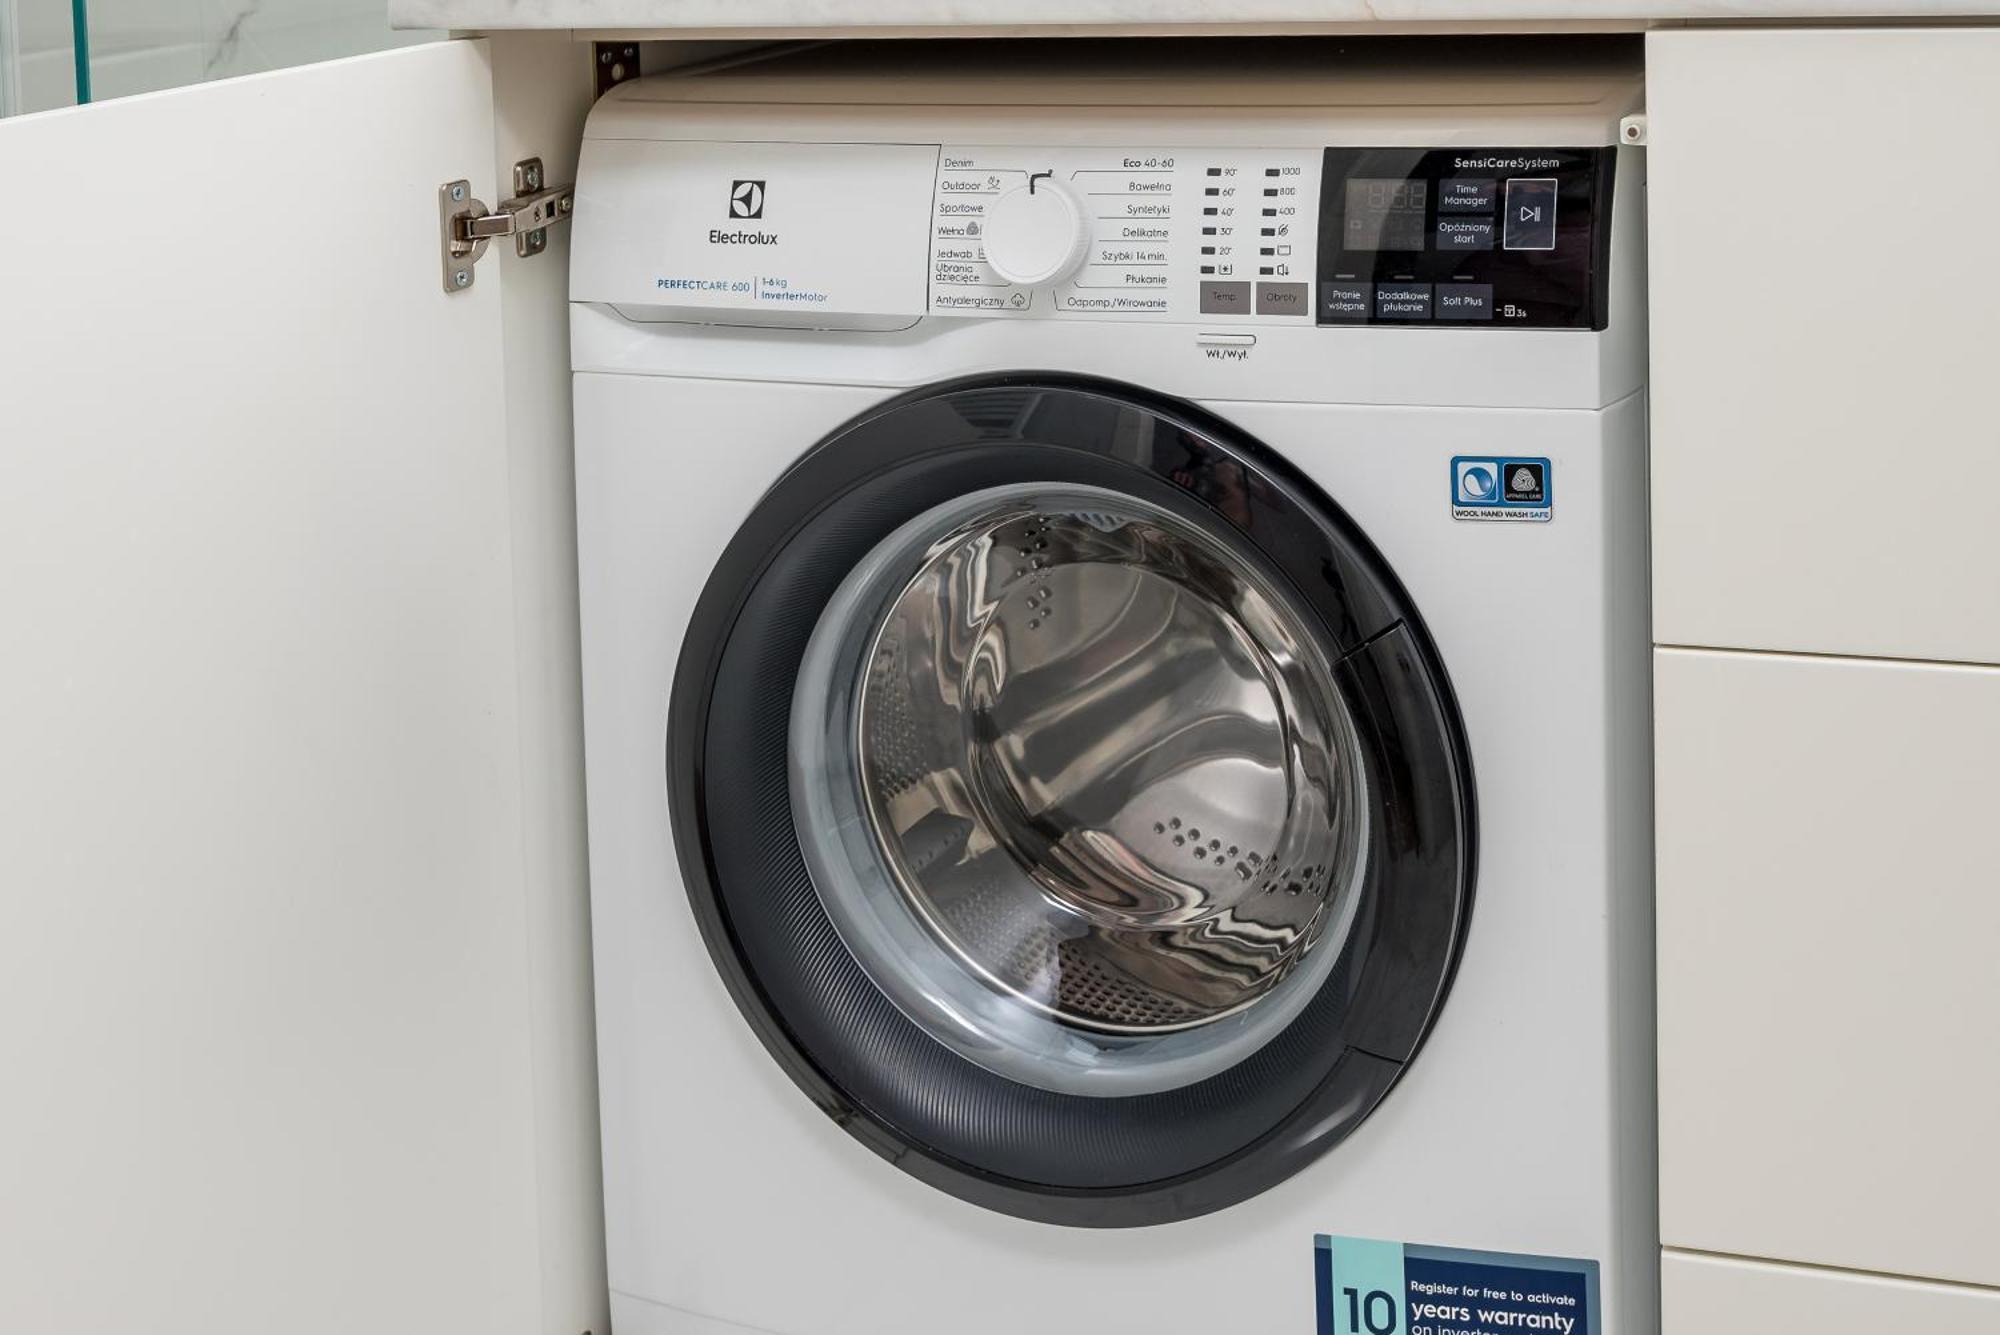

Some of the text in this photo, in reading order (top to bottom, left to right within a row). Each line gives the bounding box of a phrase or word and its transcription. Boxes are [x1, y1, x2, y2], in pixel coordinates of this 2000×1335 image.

[944, 158, 974, 168] Denim
[1123, 158, 1174, 168] Eco 40-60
[1454, 158, 1560, 170] SensiCareSystem
[1281, 167, 1301, 176] 1000
[941, 181, 981, 190] Outdoor
[1455, 184, 1478, 194] Time
[1280, 187, 1296, 196] 800
[1444, 196, 1488, 207] Manager
[939, 203, 984, 214] Sportowe
[1127, 204, 1170, 216] Syntetyki
[1279, 207, 1296, 216] 400
[709, 230, 778, 246] Electrolux
[1122, 227, 1169, 238] Delikatne
[1453, 234, 1475, 245] start
[937, 249, 973, 259] Jedwab
[1102, 250, 1168, 262] Szybki 14 min.
[935, 263, 973, 273] Ubrania
[762, 277, 788, 289] 1-6 kg
[1126, 274, 1168, 284] Płukanie
[657, 279, 750, 292] PERFECTCARE 600
[761, 290, 828, 302] InverterMotor
[1266, 292, 1297, 303] Obroty
[1332, 290, 1361, 300] Pranie
[1377, 291, 1430, 301] Dodatkowe
[935, 295, 1005, 307] Antyalergiczny
[1443, 296, 1483, 307] Soft Plus
[1383, 302, 1424, 314] płukanie
[1516, 308, 1527, 318] 3s
[1455, 509, 1549, 519] WOOL HAND WASH SAFE
[1410, 1280, 1576, 1307] Register for free to activate
[1343, 1286, 1397, 1335] 10
[1411, 1301, 1575, 1335] years warranty
[1411, 1325, 1433, 1335] on
